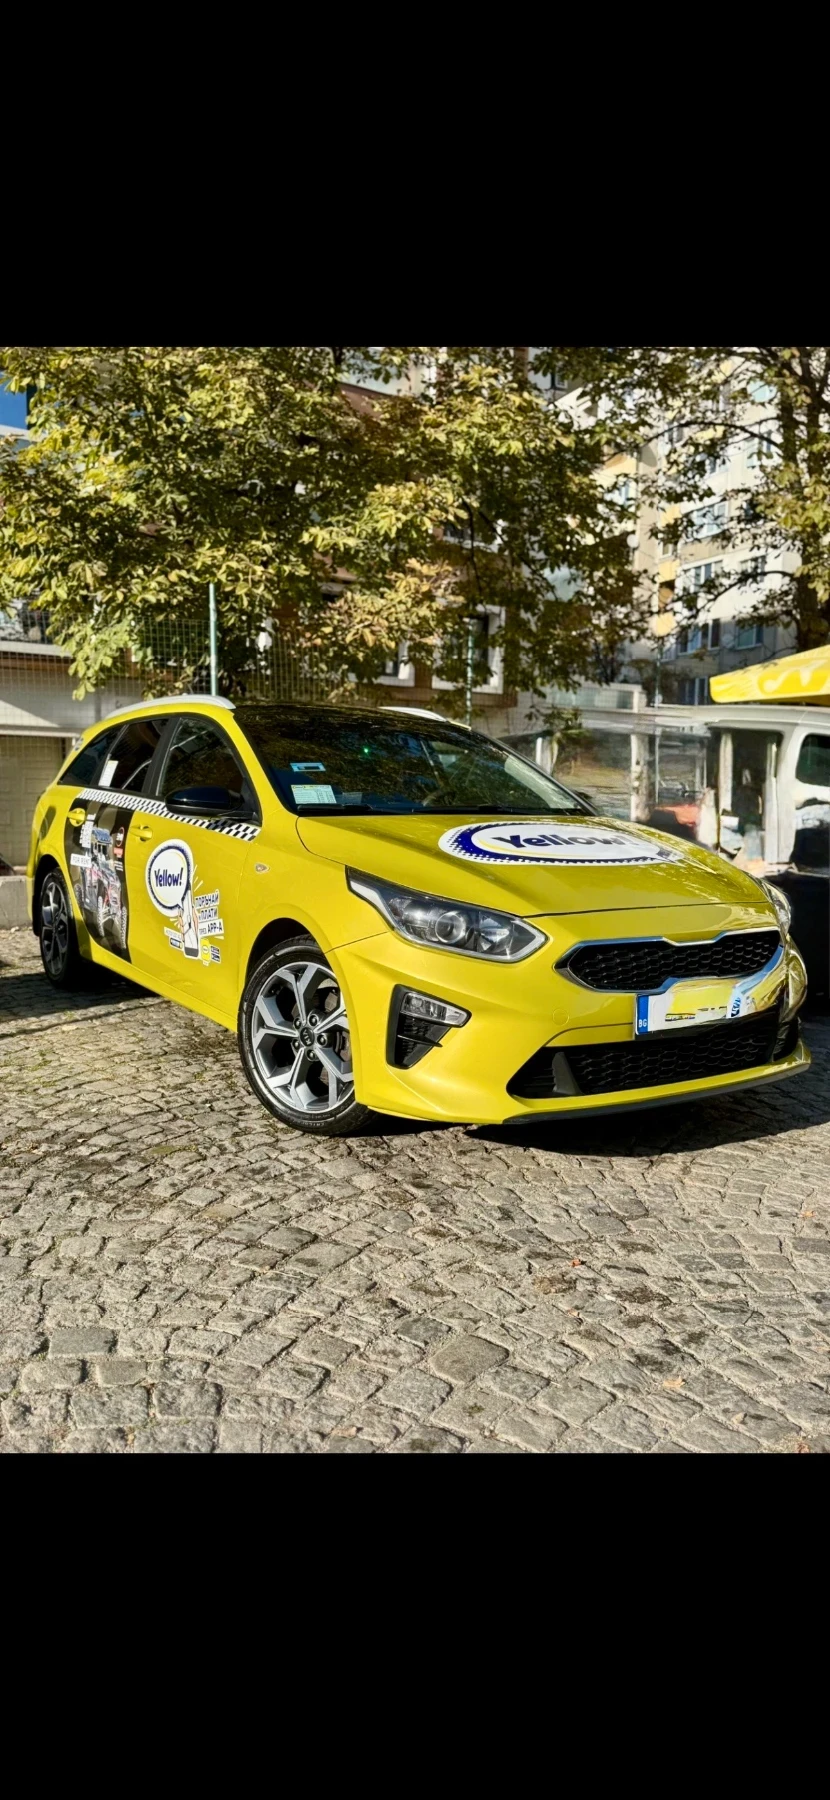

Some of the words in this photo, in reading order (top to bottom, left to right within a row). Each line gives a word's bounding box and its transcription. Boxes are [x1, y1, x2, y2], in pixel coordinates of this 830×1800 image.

[492, 834, 638, 849] Yellow!
[154, 867, 183, 887] Yellow!
[638, 1018, 648, 1027] BG
